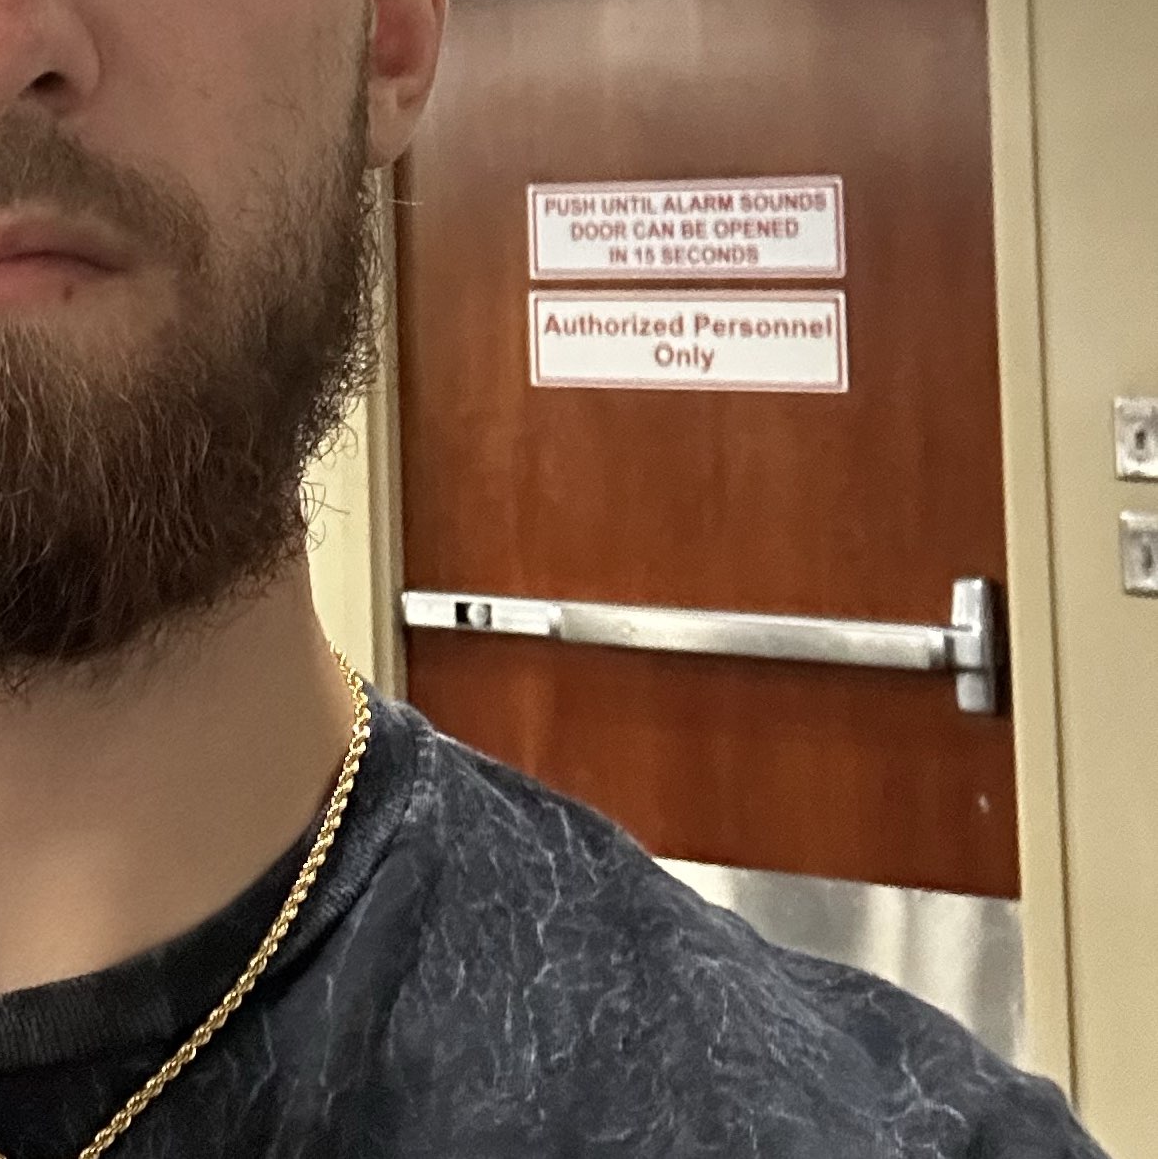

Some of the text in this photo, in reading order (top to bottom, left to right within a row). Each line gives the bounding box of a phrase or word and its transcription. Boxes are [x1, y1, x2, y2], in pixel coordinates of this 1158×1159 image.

[544, 191, 827, 218] PUSH UNTIL ALARM SOUNDS
[570, 217, 799, 241] DOOR CAN BE OPENED
[609, 244, 759, 265] IN 15 SECONDS
[544, 312, 832, 338] Authorized Personnel
[654, 342, 715, 373] Only
